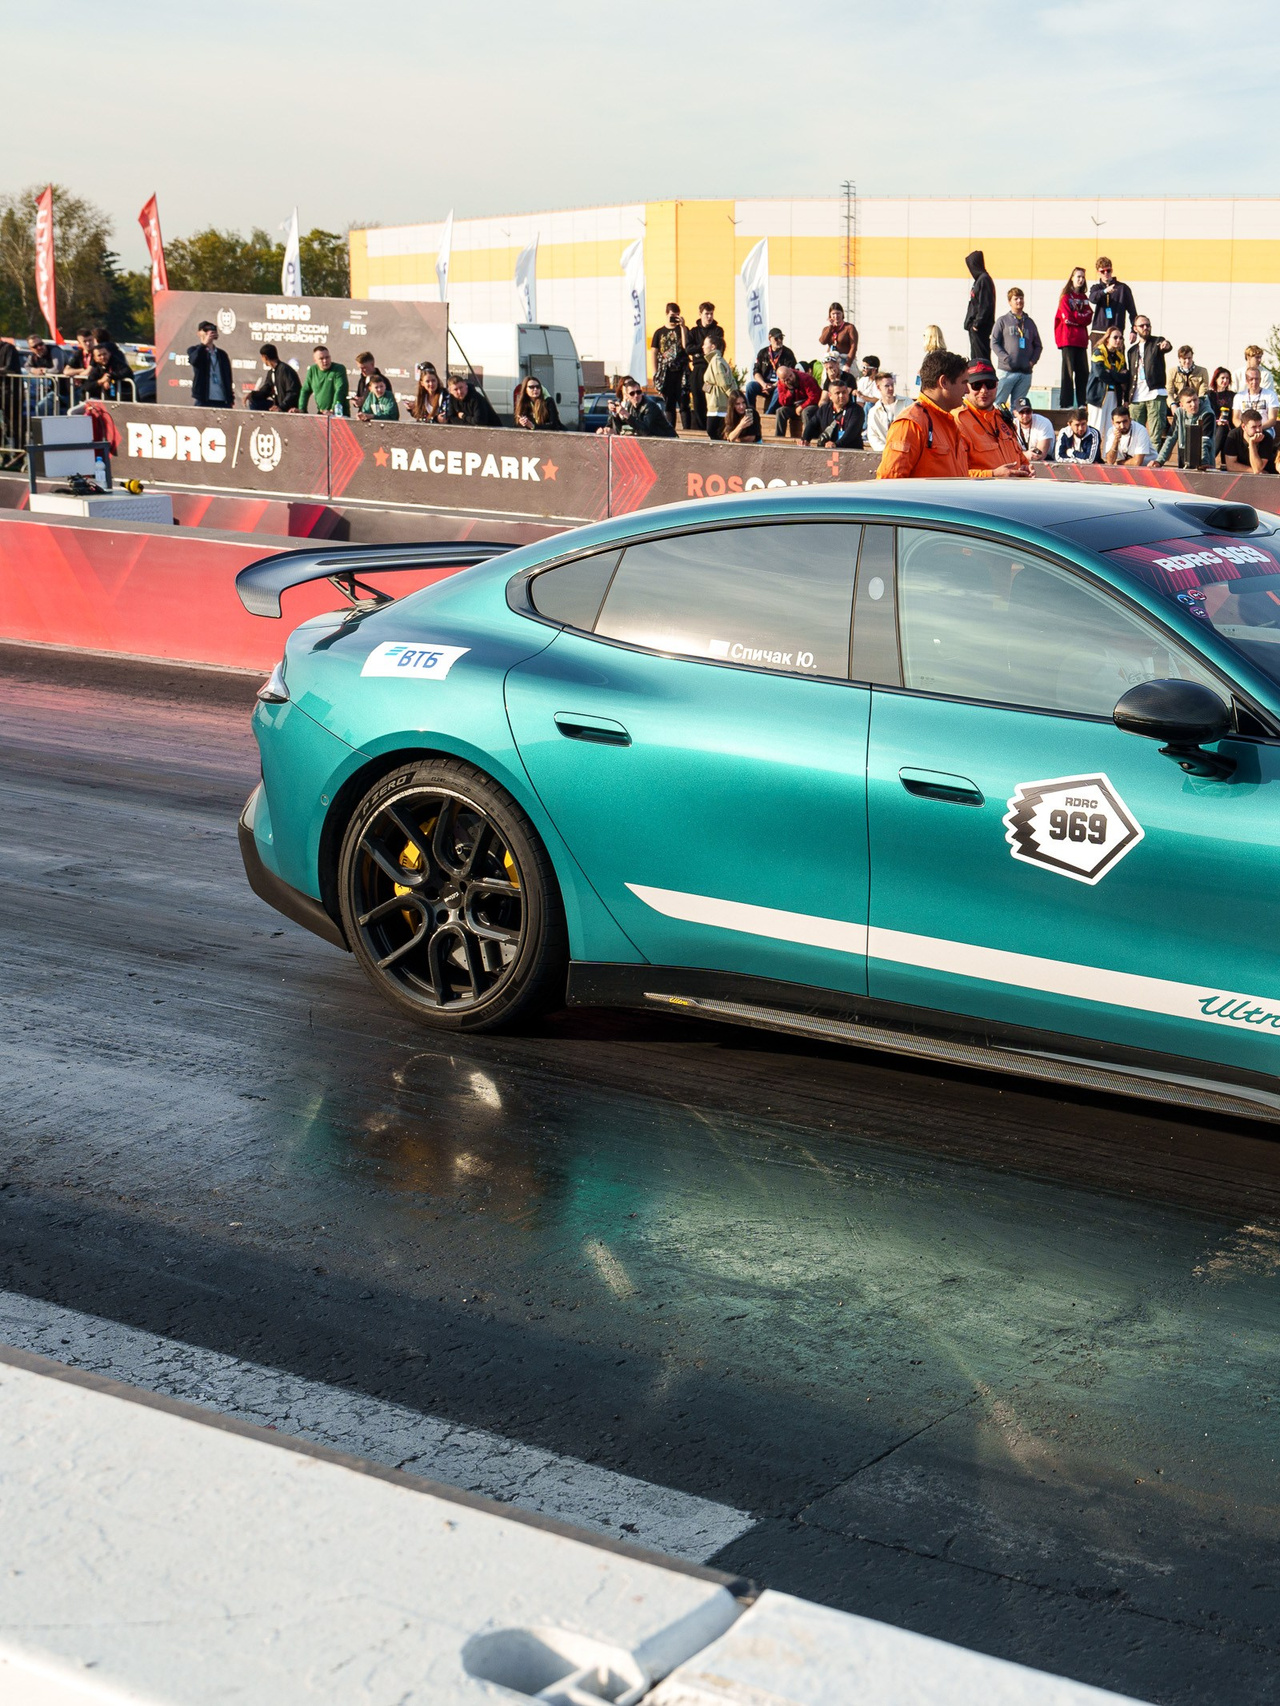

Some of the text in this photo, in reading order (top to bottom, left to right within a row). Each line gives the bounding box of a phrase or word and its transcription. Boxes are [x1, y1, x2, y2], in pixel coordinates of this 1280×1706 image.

[350, 323, 367, 335] ВТБ
[390, 447, 541, 482] RACEPARK
[1212, 545, 1271, 565] 969
[397, 650, 444, 669] ВТБ
[730, 643, 818, 669] Спичак Ю.
[372, 775, 407, 805] ZERO
[1049, 809, 1108, 845] 969
